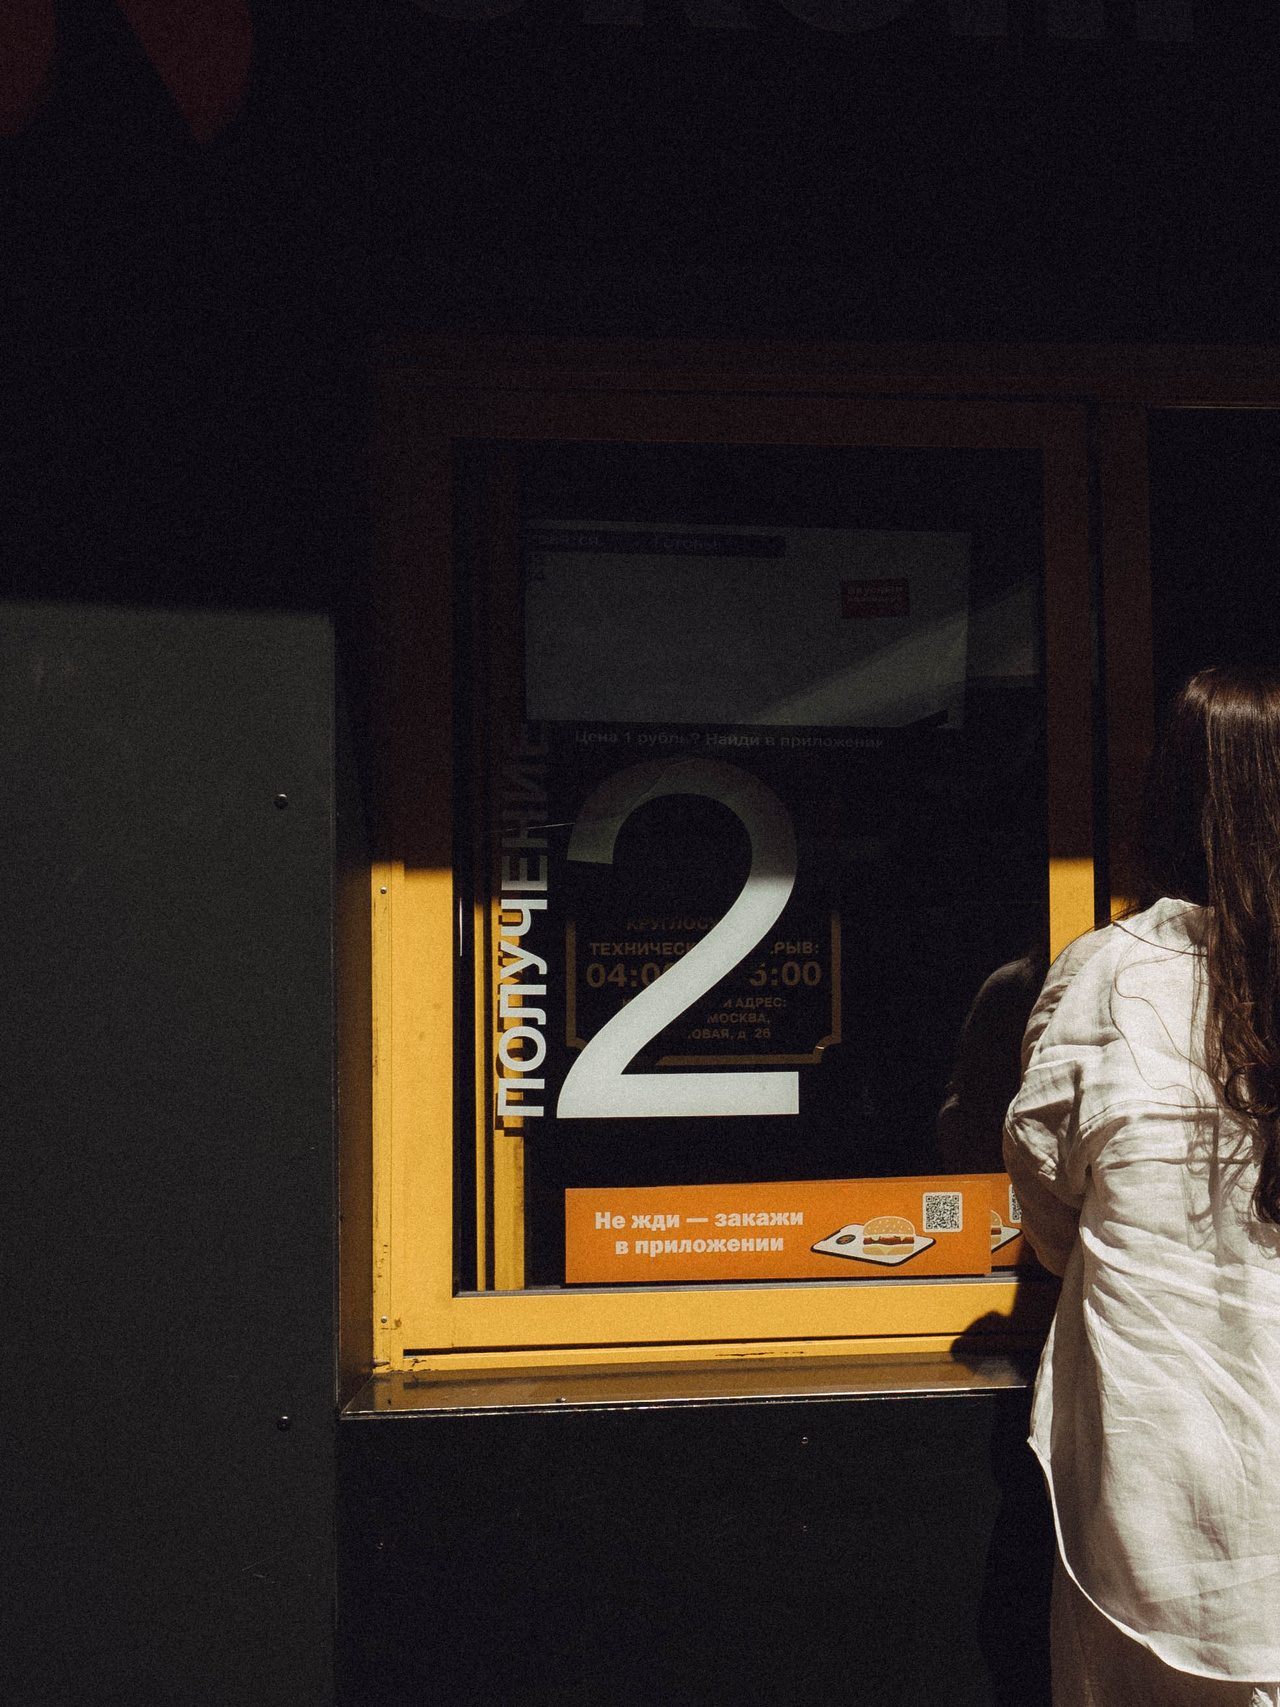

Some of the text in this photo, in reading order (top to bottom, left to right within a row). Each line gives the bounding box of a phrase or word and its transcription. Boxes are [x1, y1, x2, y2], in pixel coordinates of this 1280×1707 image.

[706, 733, 760, 748] Найди
[497, 723, 548, 1117] ПОЛУЧЕНИЕ
[556, 757, 799, 1118] 2
[586, 963, 676, 988] 04:0
[688, 1029, 734, 1040] ОВАЯ,
[595, 1211, 625, 1229] Не
[631, 1211, 680, 1232] жди
[714, 1211, 804, 1227] закажи
[614, 1235, 784, 1258] в приложении
